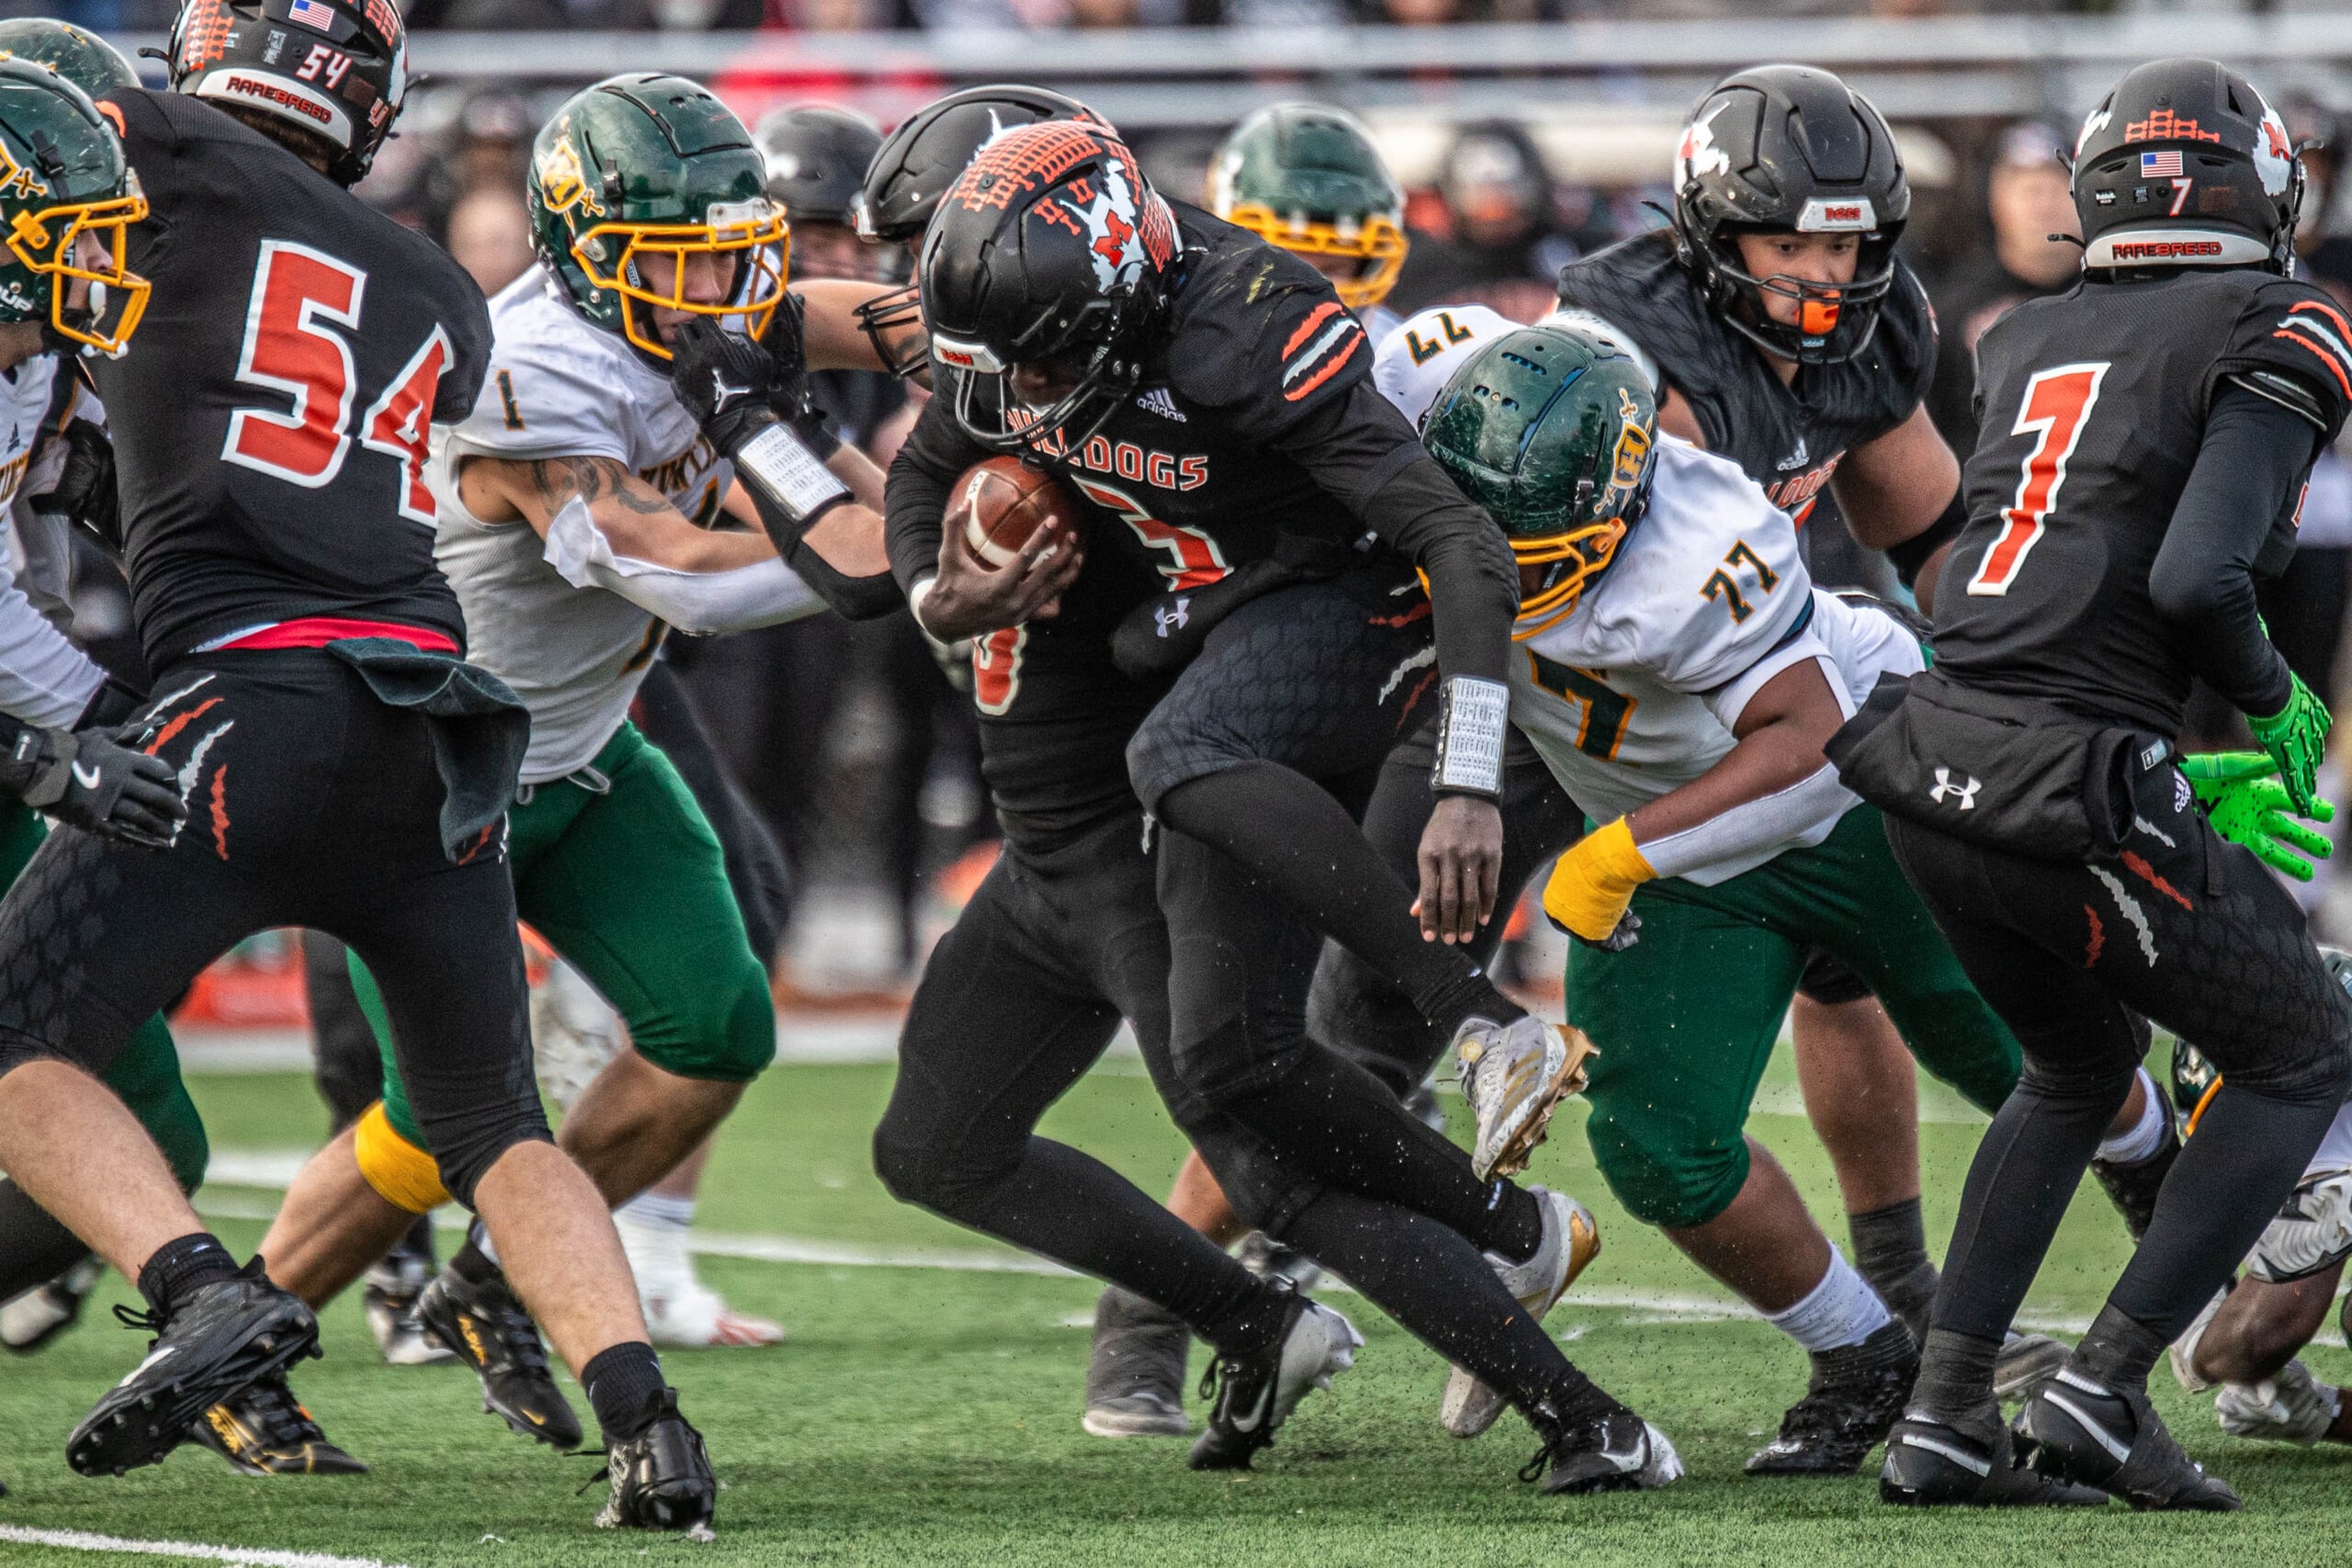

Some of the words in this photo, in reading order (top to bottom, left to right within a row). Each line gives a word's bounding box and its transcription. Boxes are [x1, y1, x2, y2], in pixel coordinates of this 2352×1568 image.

[295, 44, 353, 89] 54
[226, 76, 334, 124] RAREBREED
[2169, 177, 2192, 216] 7
[2112, 242, 2222, 260] RAREBREED
[220, 239, 455, 530] 54
[496, 369, 526, 432] 1
[1136, 397, 1187, 423] adidas
[1967, 361, 2111, 597] 7
[1699, 538, 1781, 627] 77
